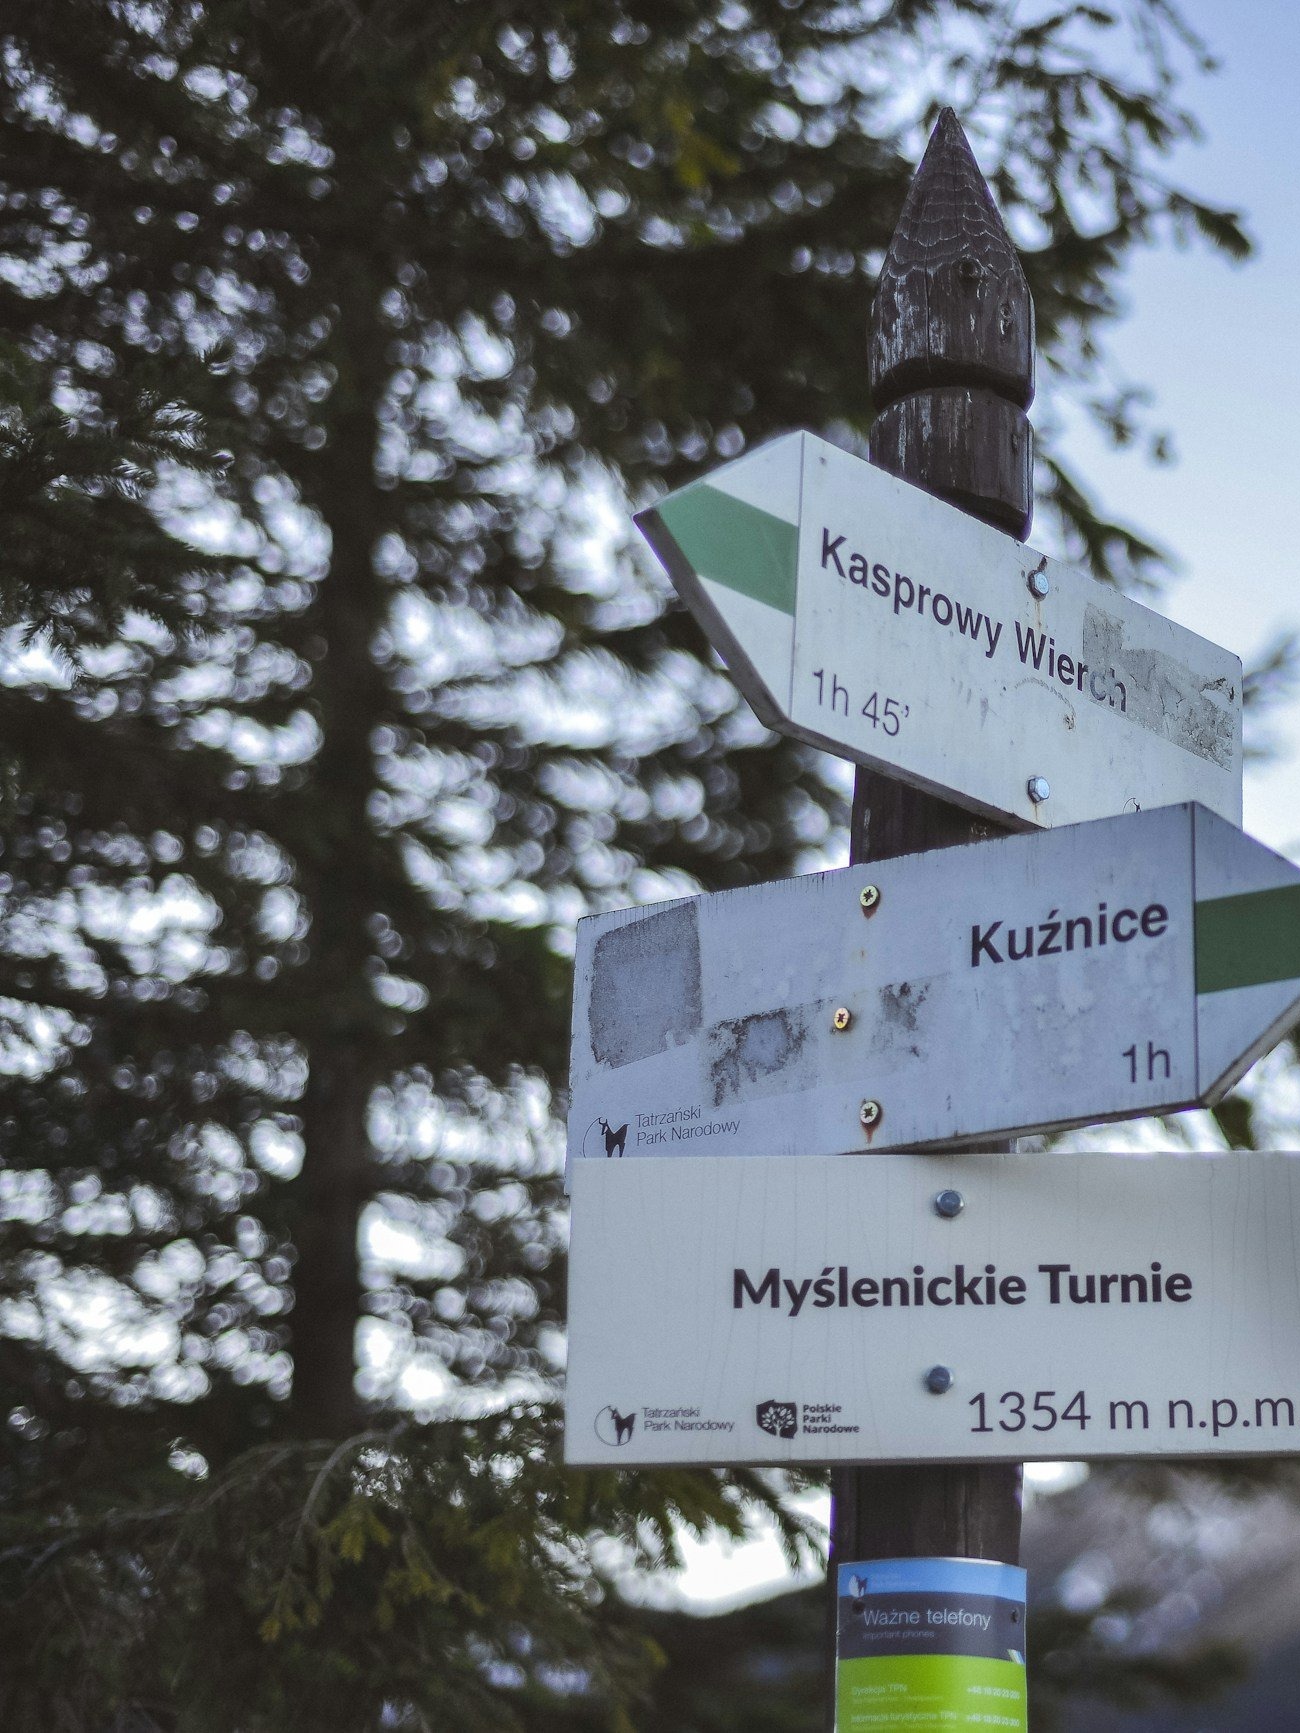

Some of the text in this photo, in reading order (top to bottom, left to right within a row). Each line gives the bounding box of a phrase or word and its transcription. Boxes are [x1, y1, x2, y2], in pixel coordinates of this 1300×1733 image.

[820, 527, 1127, 713] Kasprowy Wierch
[812, 668, 851, 717] 1h
[970, 901, 1169, 968] Kuźnice
[1122, 1040, 1171, 1083] 1h
[635, 1105, 701, 1128] Tatrzański
[636, 1120, 741, 1146] Park Narodowy
[732, 1261, 1193, 1317] Myślenickie Turnie
[641, 1406, 701, 1418] Tatrzański
[803, 1403, 842, 1413] Polskie
[803, 1413, 832, 1423] Parki
[968, 1390, 1091, 1432] 1354
[1109, 1398, 1149, 1431] m
[643, 1419, 735, 1432] Park Narodowy
[803, 1424, 860, 1433] Narodowe
[863, 1607, 991, 1631] Ważne telefony
